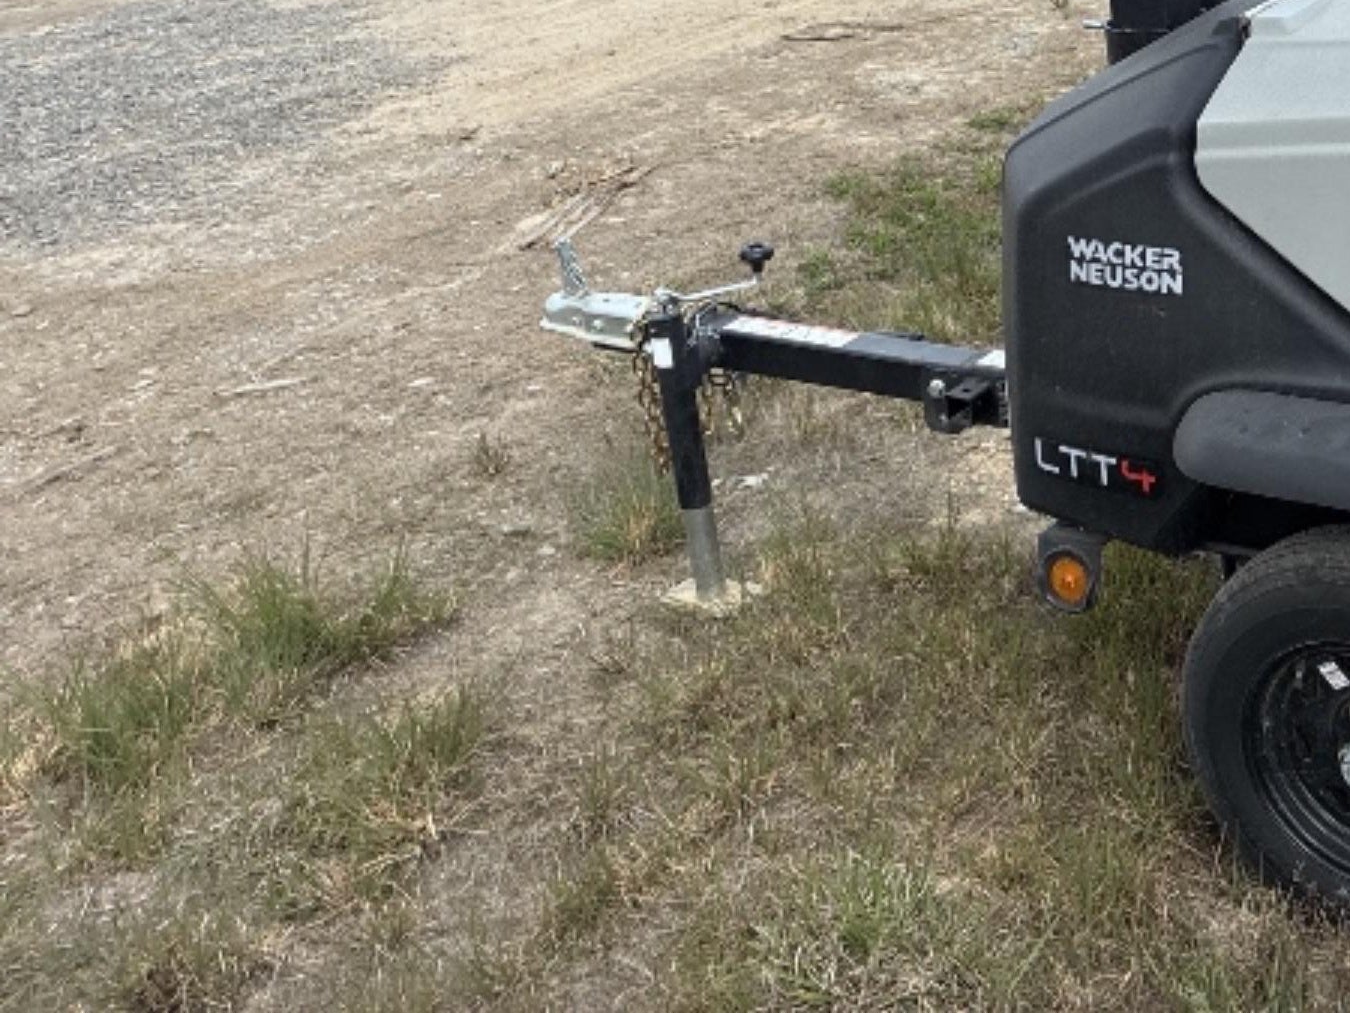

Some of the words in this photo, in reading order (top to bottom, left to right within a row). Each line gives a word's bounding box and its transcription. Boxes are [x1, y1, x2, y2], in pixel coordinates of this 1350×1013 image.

[1067, 236, 1184, 275] WACKER
[1069, 259, 1184, 296] NEUSON
[1034, 436, 1156, 493] LTT4
